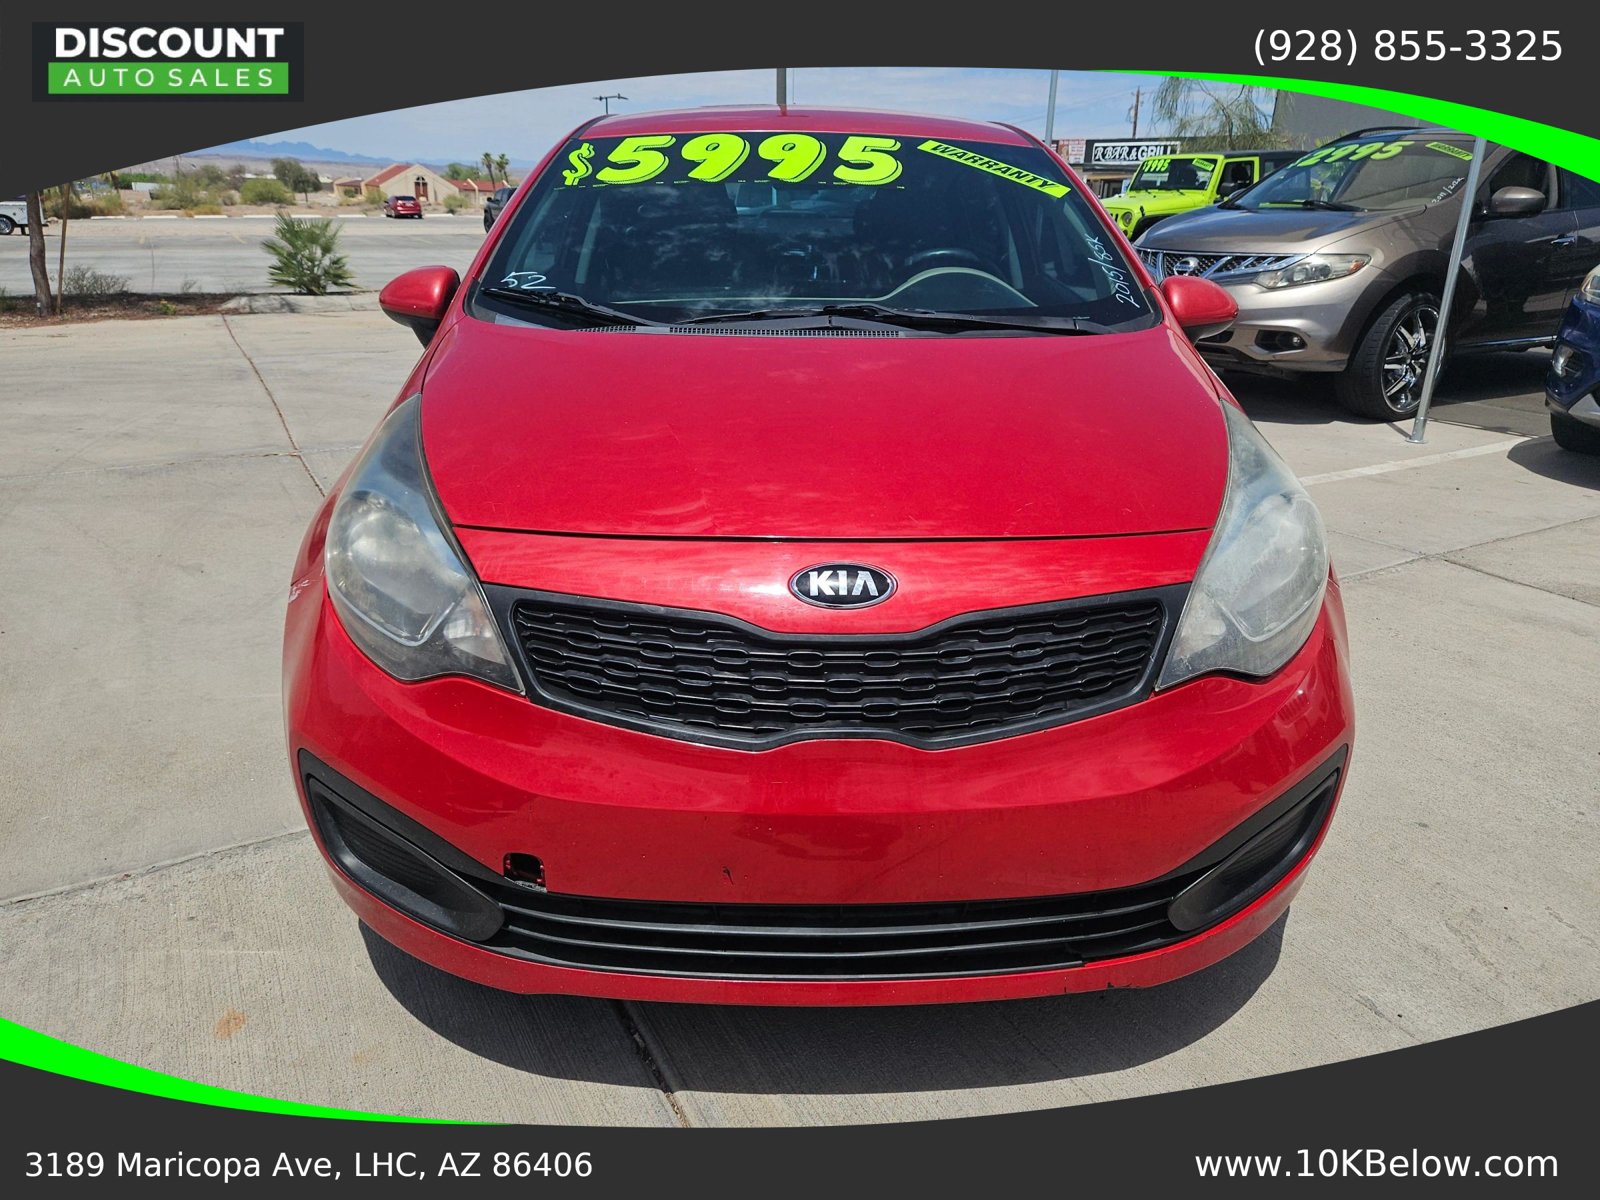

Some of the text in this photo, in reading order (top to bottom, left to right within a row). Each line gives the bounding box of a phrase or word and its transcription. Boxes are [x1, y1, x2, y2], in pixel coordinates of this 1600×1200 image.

[562, 133, 903, 186] $5995
[931, 144, 1055, 189] WARRANTY
[500, 271, 556, 289] 52
[808, 570, 879, 596] KIA
